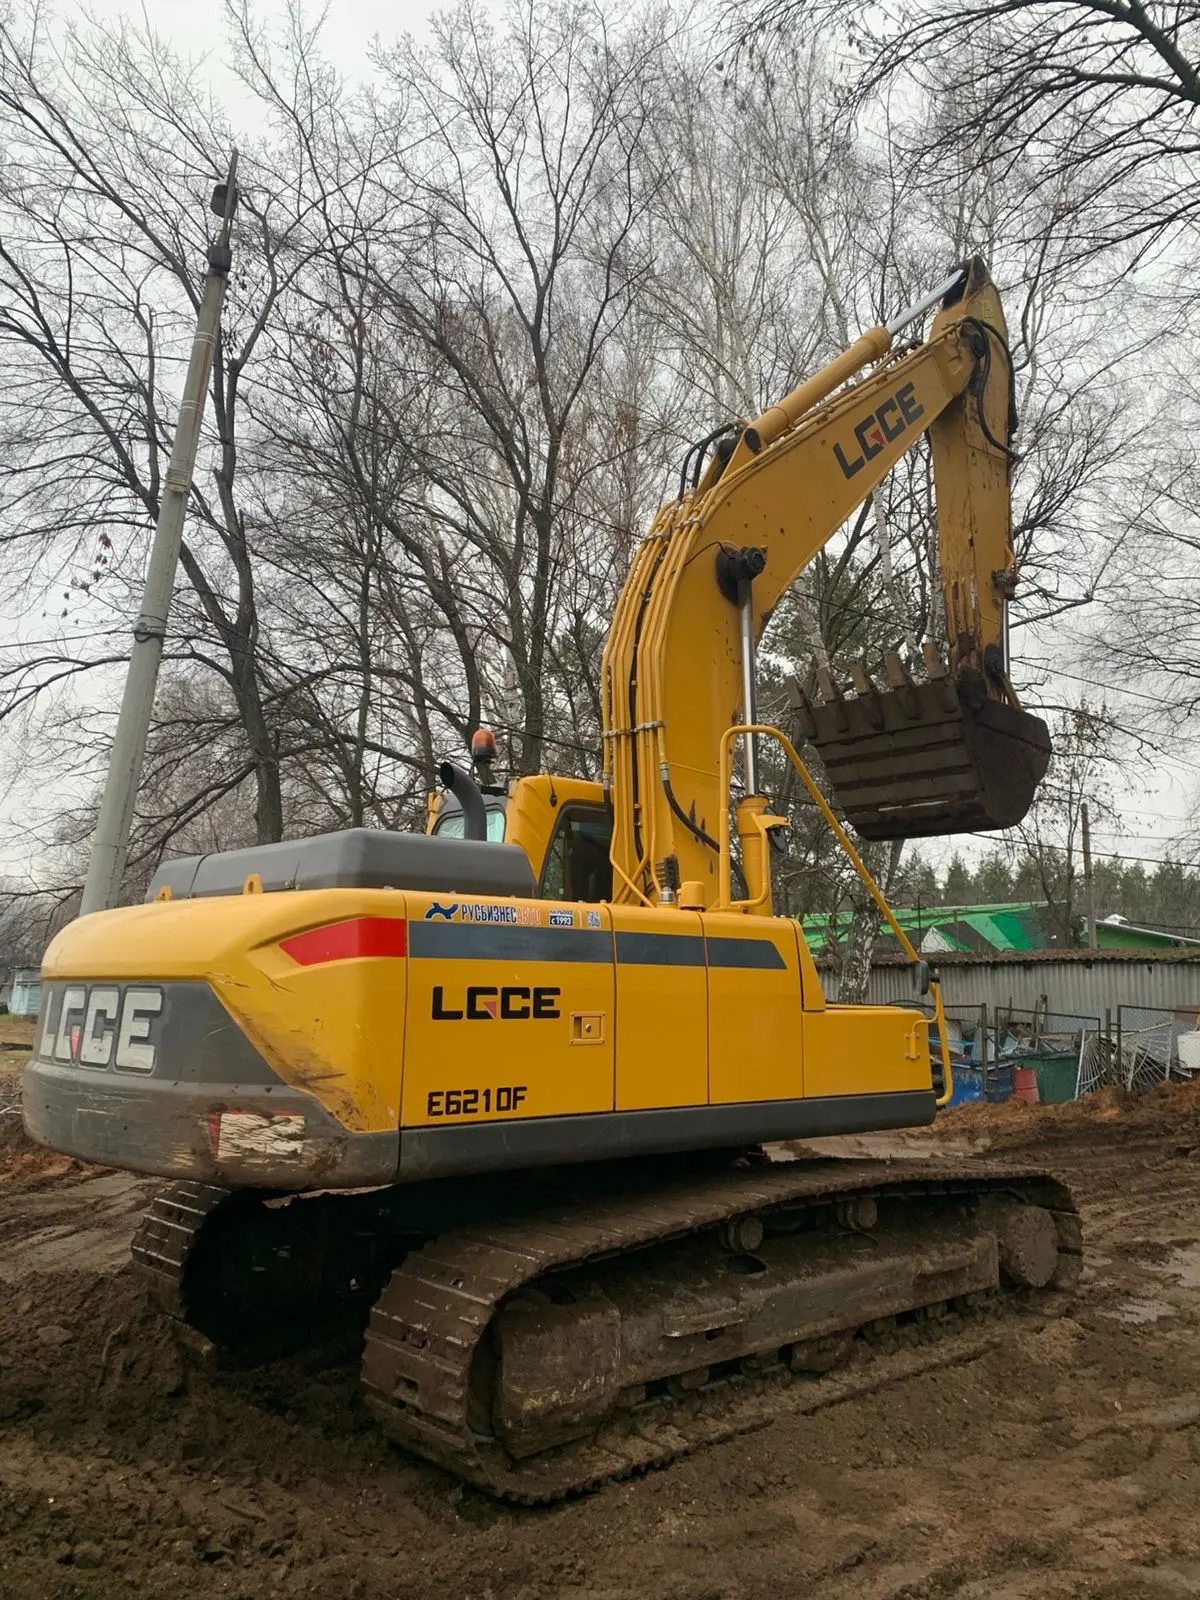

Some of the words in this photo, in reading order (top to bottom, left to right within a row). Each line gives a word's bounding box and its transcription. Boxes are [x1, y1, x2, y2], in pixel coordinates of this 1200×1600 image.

[833, 382, 925, 479] LGCE
[461, 904, 541, 924] РУСБИЗНЕСАВТО
[432, 986, 561, 1020] LGCE
[40, 984, 162, 1070] LGCE
[427, 1086, 528, 1116] E6210F
